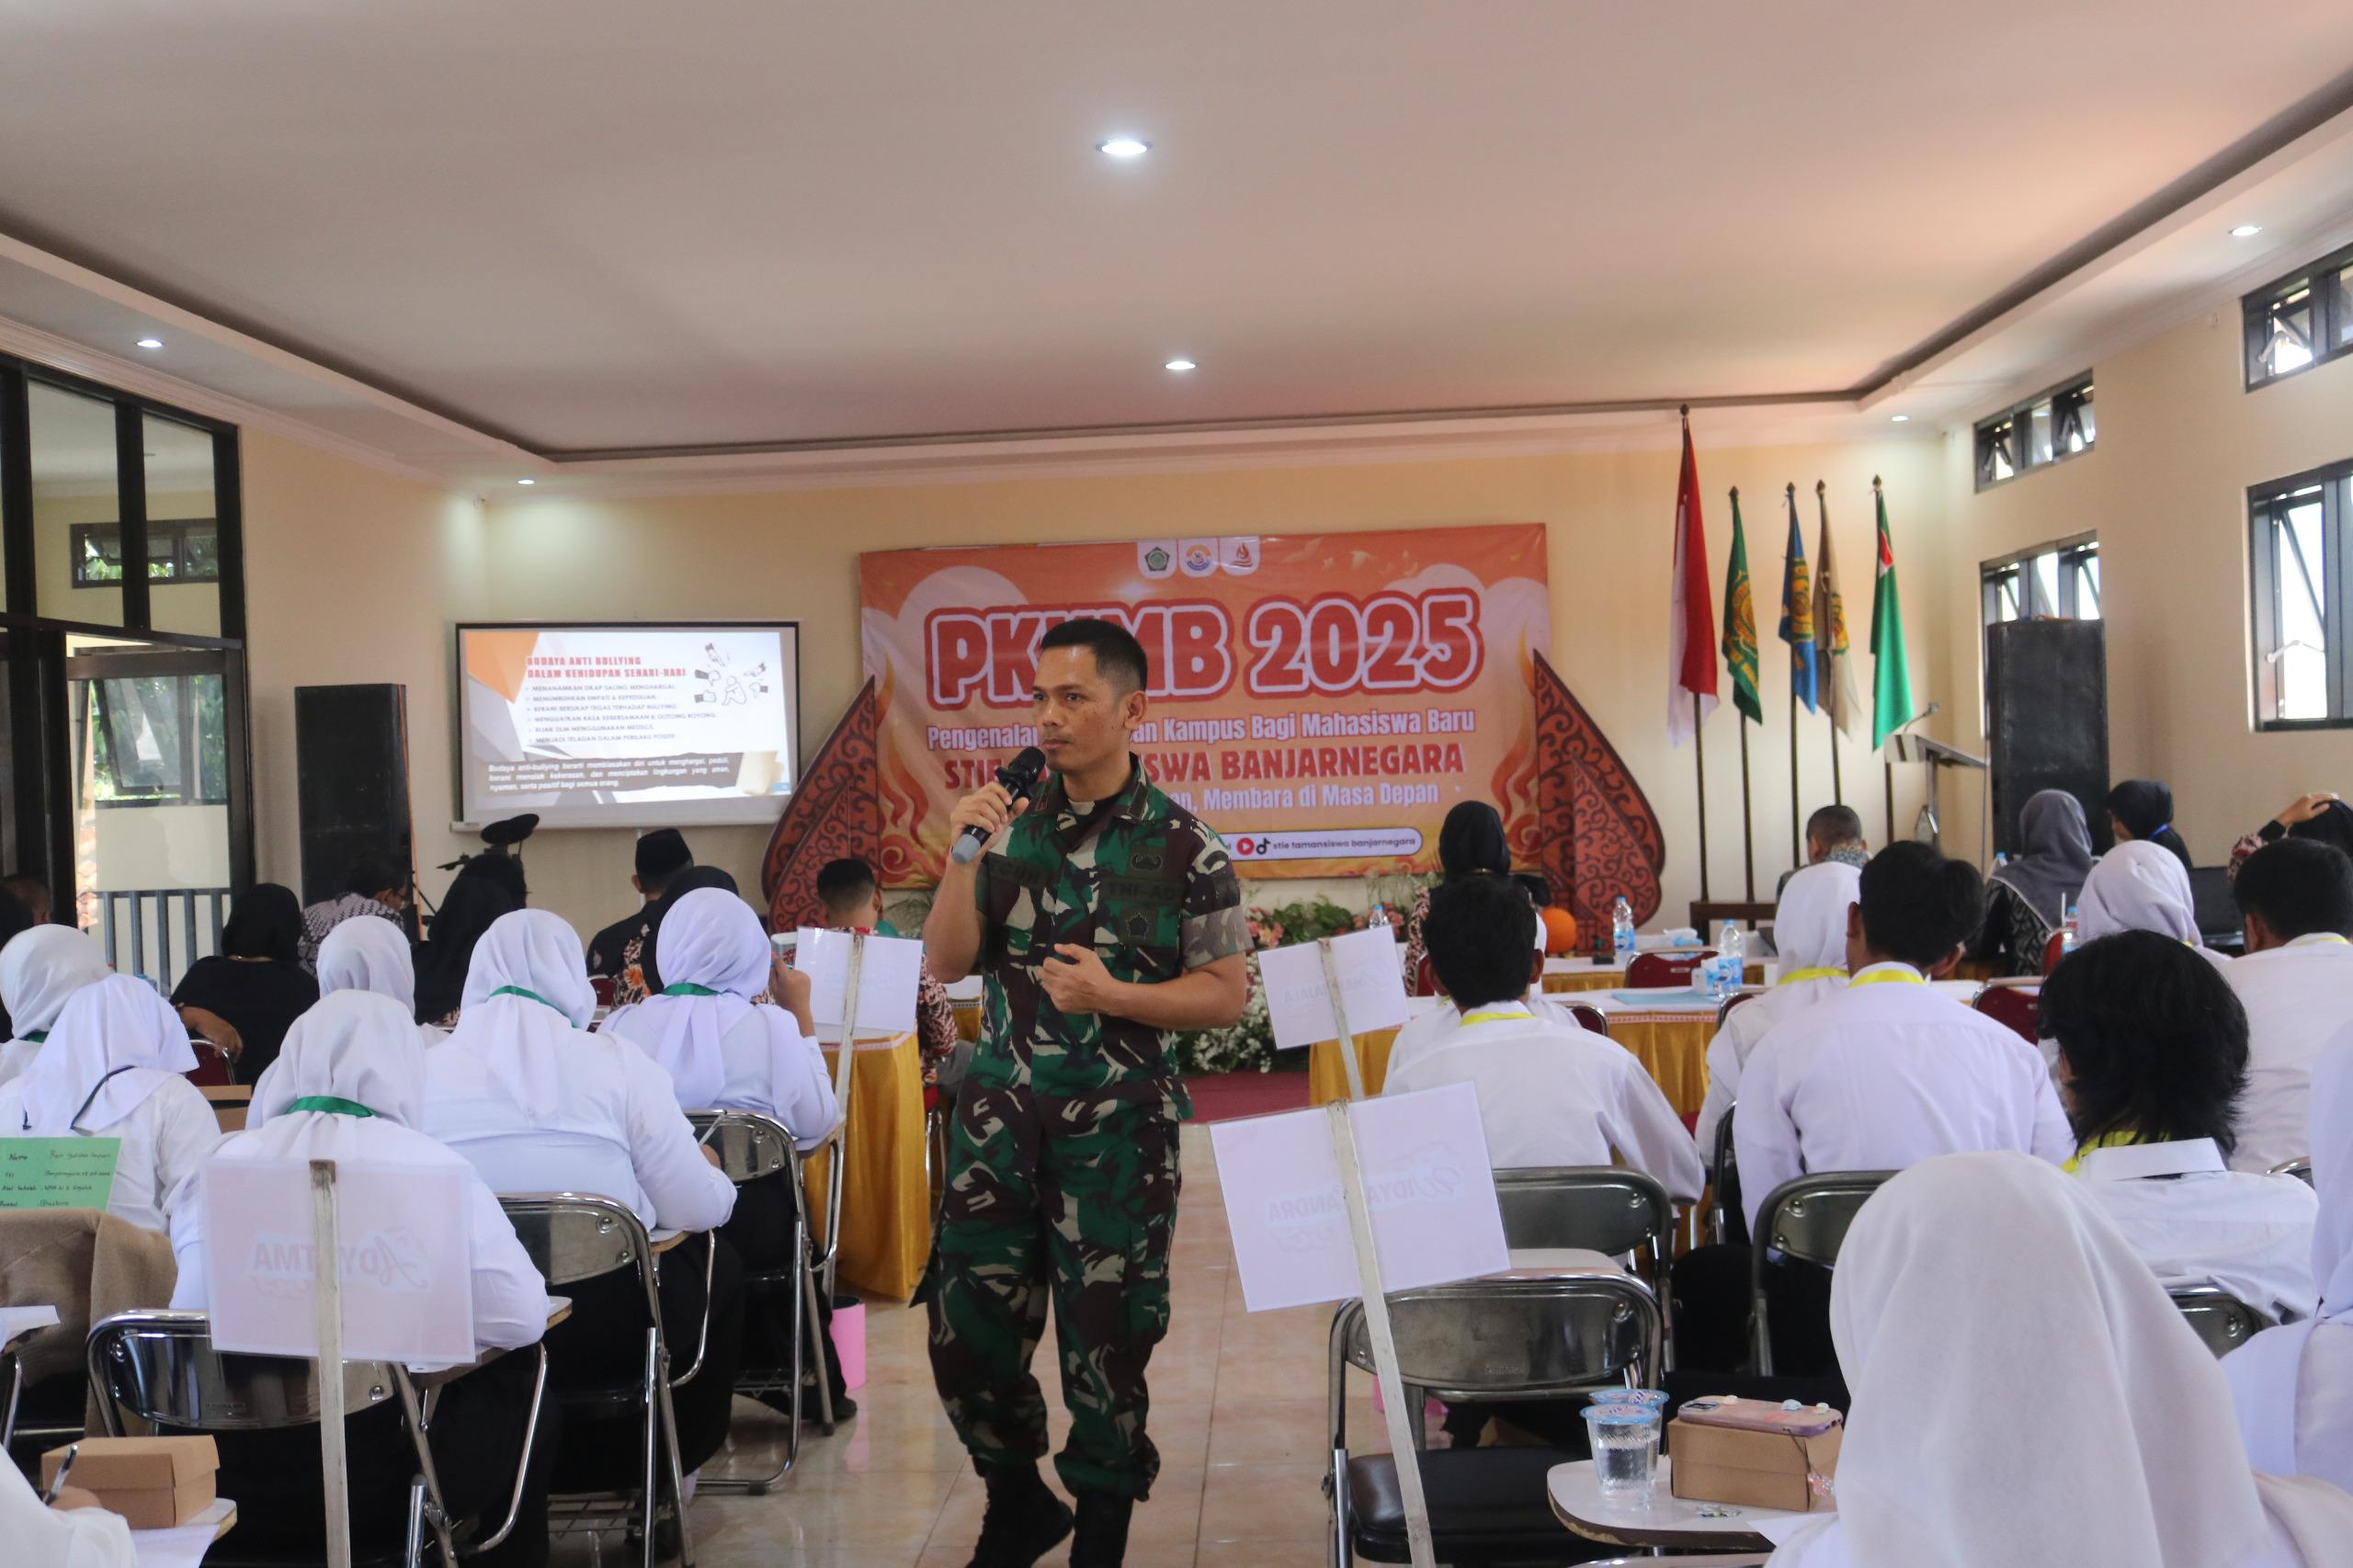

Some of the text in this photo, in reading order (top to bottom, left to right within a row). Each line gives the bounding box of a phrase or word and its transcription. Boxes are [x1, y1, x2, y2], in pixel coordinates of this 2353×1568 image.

[1245, 591, 1481, 696] 2025
[528, 656, 642, 665] BUDAYA ANTI BULLYING
[528, 668, 686, 678] DALAM KEHIDUPAN SEHARI-HARI
[1164, 718, 1245, 744] Kampus
[1251, 713, 1296, 740] Bagi
[1302, 710, 1421, 737] Mahasiswa
[1427, 709, 1474, 733] Baru
[1222, 744, 1466, 780] BANJARNEGARA
[1203, 788, 1294, 811] Membara
[1299, 784, 1316, 808] di
[1322, 783, 1375, 807] Masa
[1380, 781, 1439, 806] Depan
[1273, 837, 1415, 850] stie tamansiswa banjarnegara
